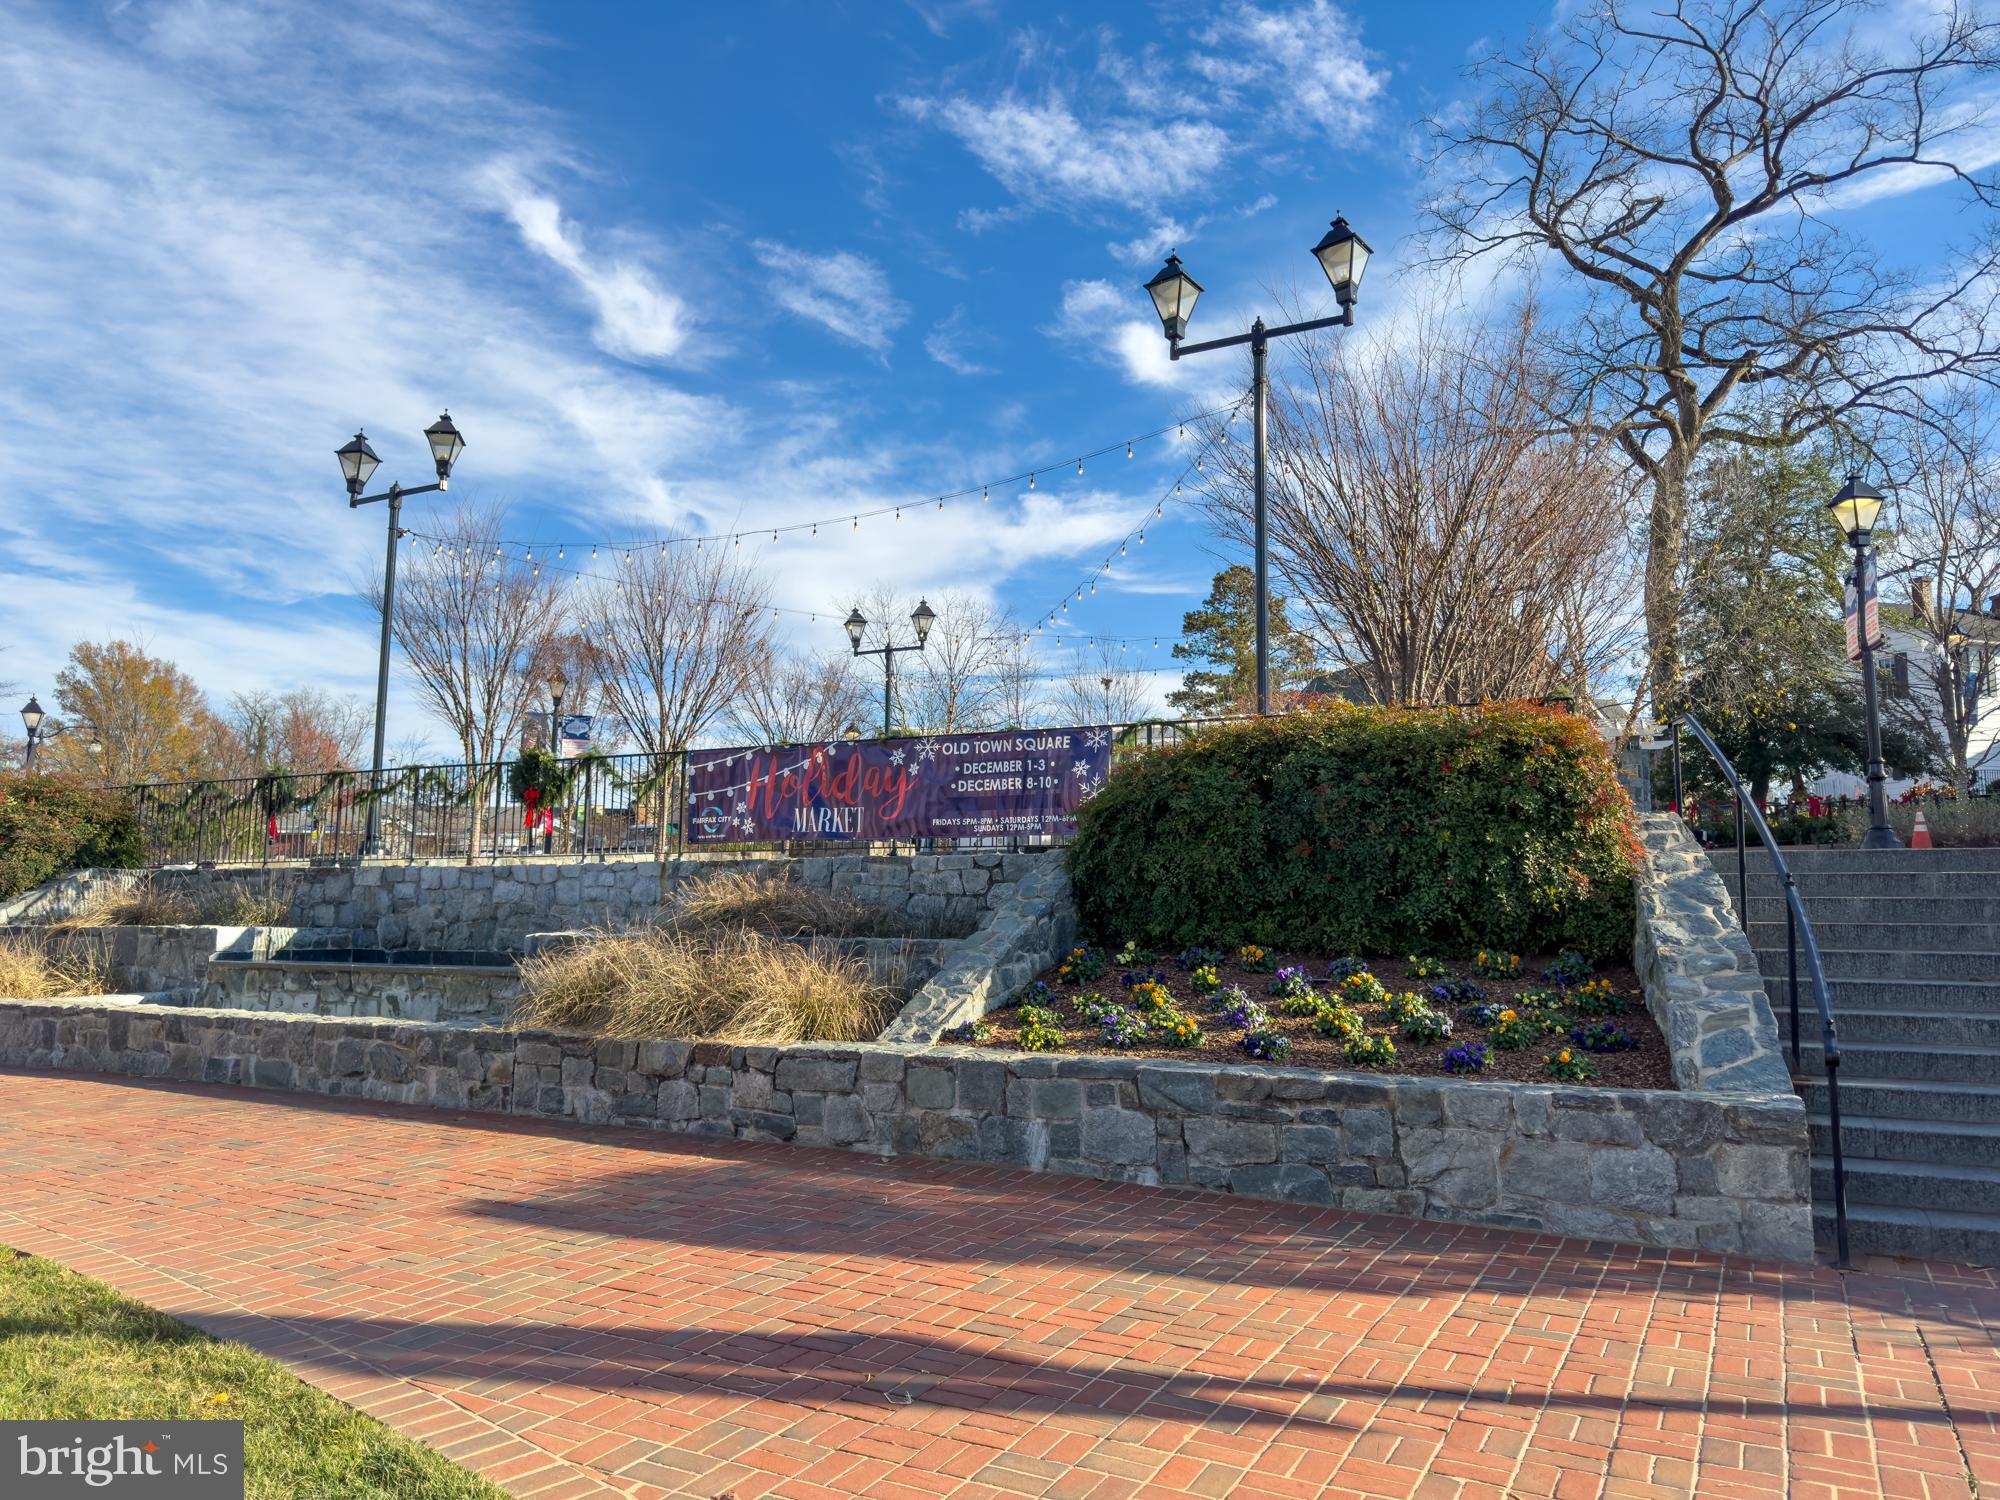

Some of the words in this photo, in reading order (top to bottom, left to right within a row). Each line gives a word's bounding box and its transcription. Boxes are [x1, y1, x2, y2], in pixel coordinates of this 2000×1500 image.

[942, 742, 969, 755] OLD
[973, 739, 1012, 754] TOWN
[1015, 736, 1071, 751] SQUARE
[963, 760, 1022, 775] DECEMBER
[1027, 759, 1046, 772] 1-3
[747, 746, 919, 821] Holiday
[958, 778, 1022, 792] DECEMBER
[1026, 776, 1051, 789] 8-10
[692, 816, 717, 824] FAIRFAX
[717, 815, 732, 823] CITY
[791, 806, 865, 833] MARKET
[932, 818, 961, 826] FRIDAYS
[962, 817, 993, 825] 5PM-8PM
[1000, 815, 1039, 824] SATURDAYS
[973, 824, 1004, 832] SUNDAYS
